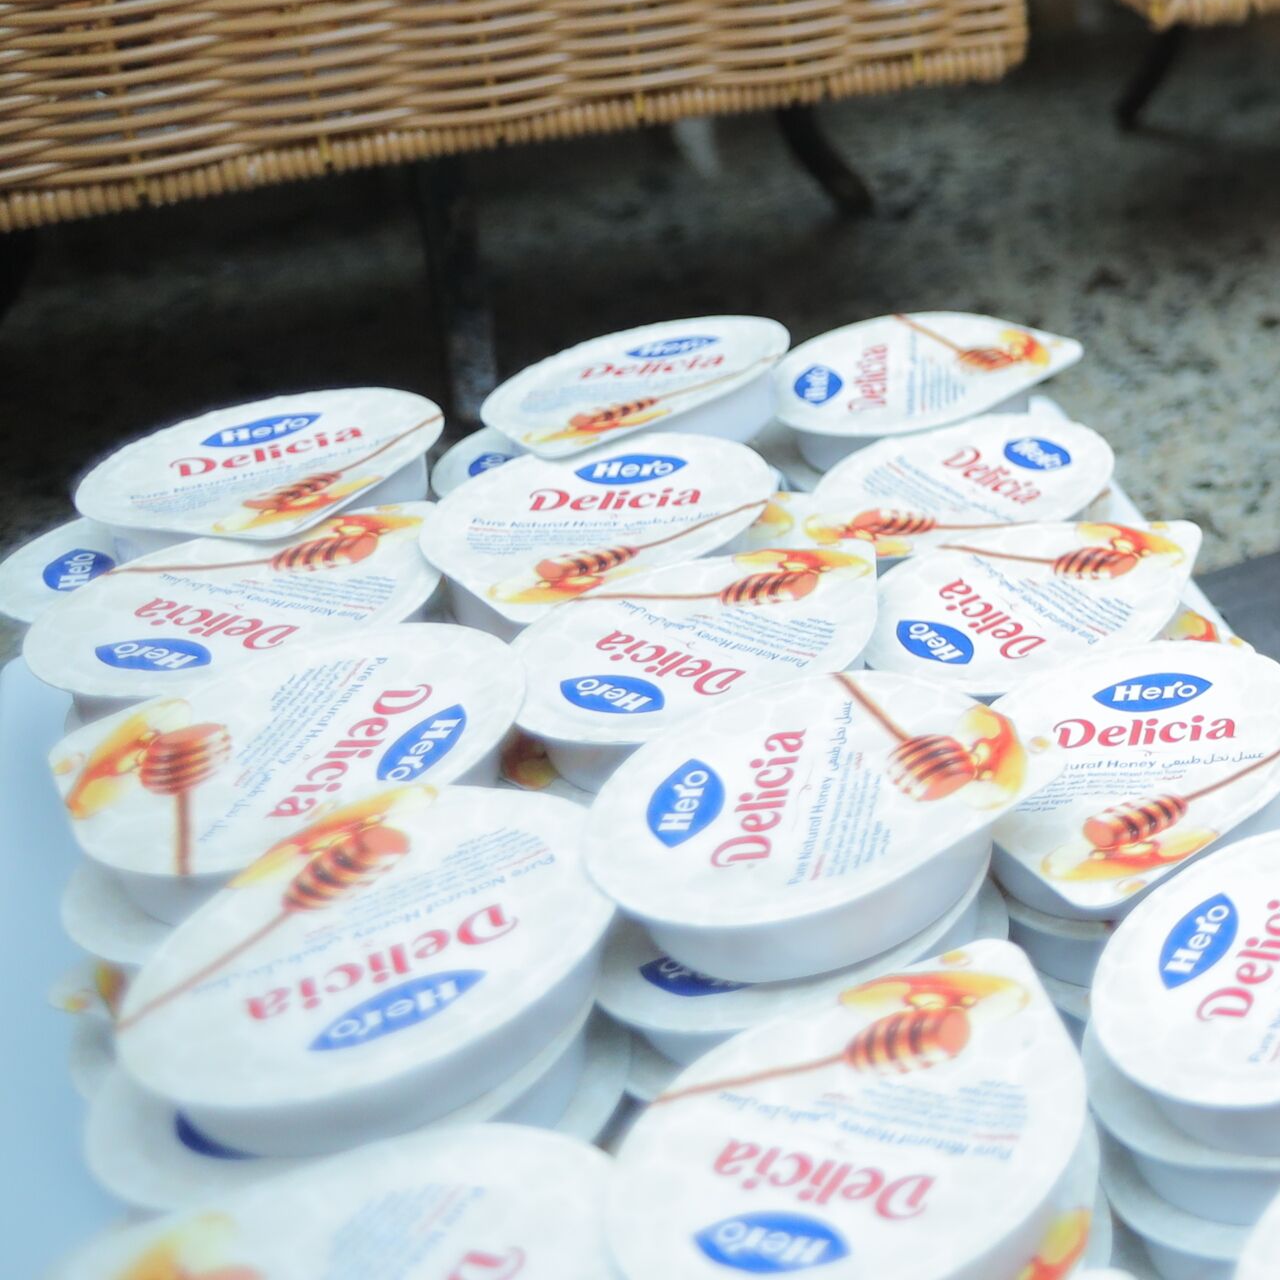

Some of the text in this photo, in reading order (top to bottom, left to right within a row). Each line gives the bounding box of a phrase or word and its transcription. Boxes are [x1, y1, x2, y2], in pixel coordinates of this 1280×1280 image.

[168, 425, 364, 478] Delicia
[220, 414, 310, 445] Hero
[593, 458, 676, 479] Hero
[942, 446, 1042, 505] Delicia
[529, 486, 702, 513] Delicia
[57, 549, 97, 592] Hero
[133, 596, 301, 650] Delicia
[908, 622, 966, 662] Hero
[938, 576, 1048, 660] Delicia
[113, 642, 199, 669] Hero
[594, 629, 748, 696] Delicia
[576, 677, 654, 712] Hero
[1112, 680, 1198, 703] Hero
[263, 683, 434, 819] Delicia
[384, 717, 464, 781] Hero
[1052, 714, 1237, 750] Delicia
[1106, 758, 1157, 770] Honey
[657, 769, 709, 833] Hero
[709, 727, 807, 868] Delicia
[245, 902, 520, 1022] Delicia
[1163, 903, 1231, 975] Hero
[329, 979, 461, 1040] Hero
[713, 1136, 937, 1221] Delicia
[715, 1221, 834, 1263] Hero
